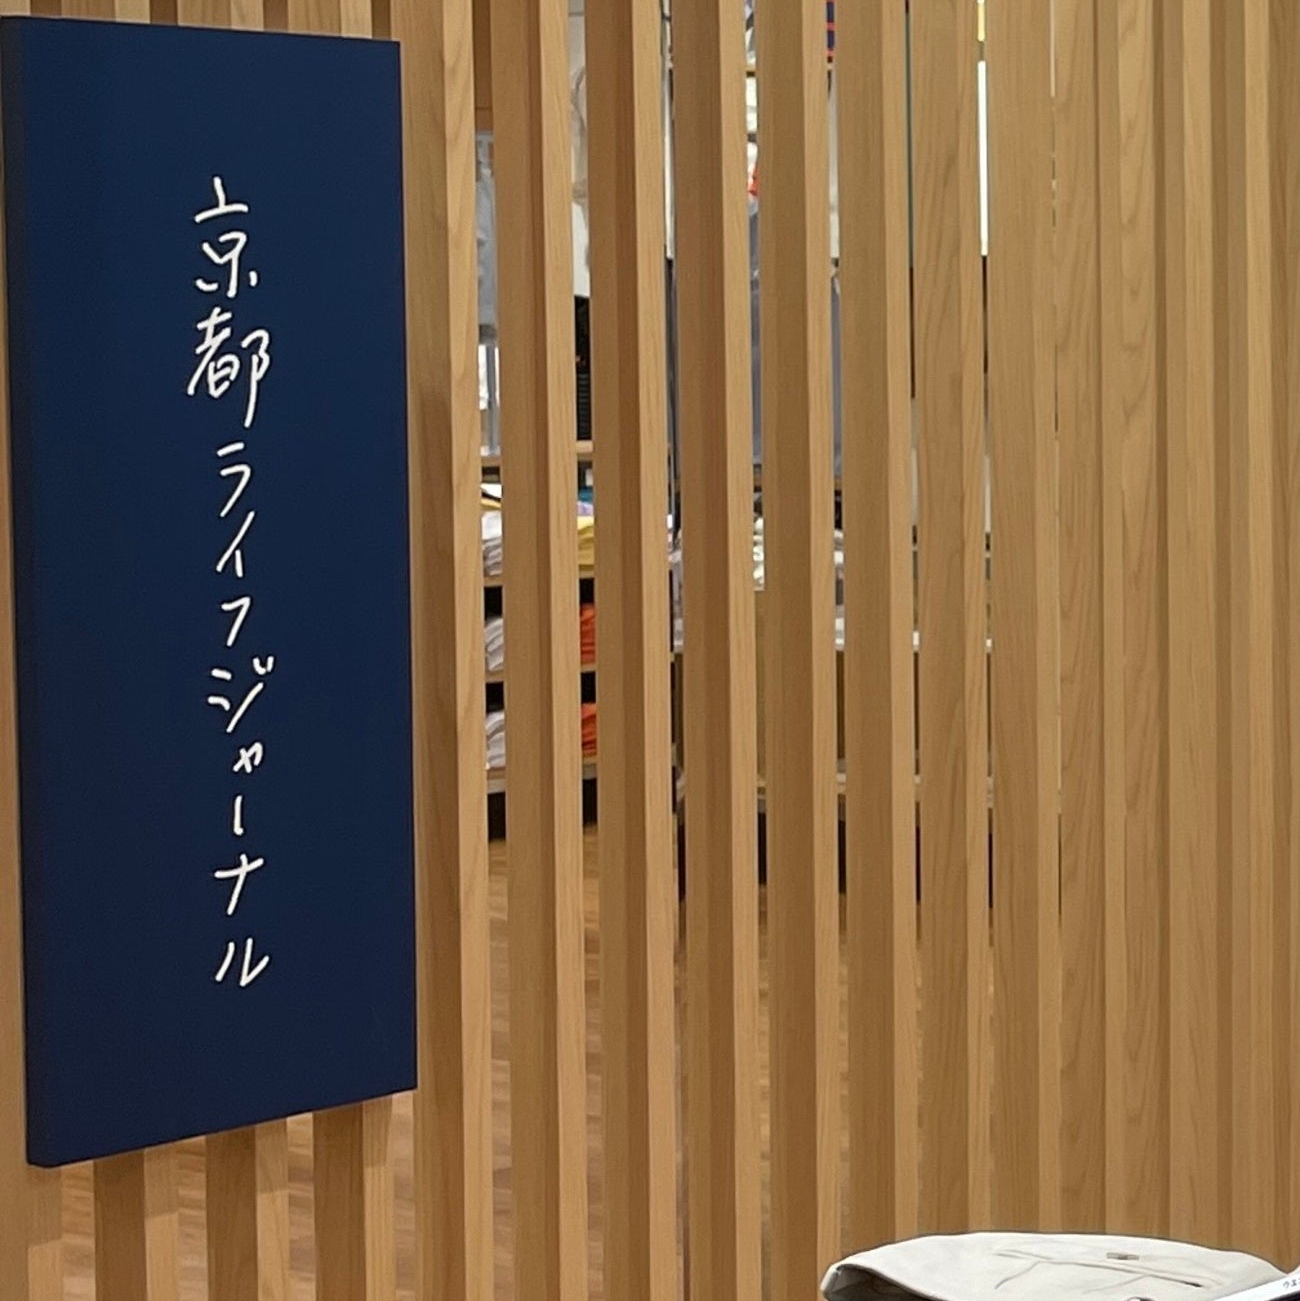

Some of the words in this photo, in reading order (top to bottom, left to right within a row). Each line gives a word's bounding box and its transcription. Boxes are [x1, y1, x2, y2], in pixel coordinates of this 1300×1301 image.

[184, 175, 275, 988] 京都ライフジャーナル
